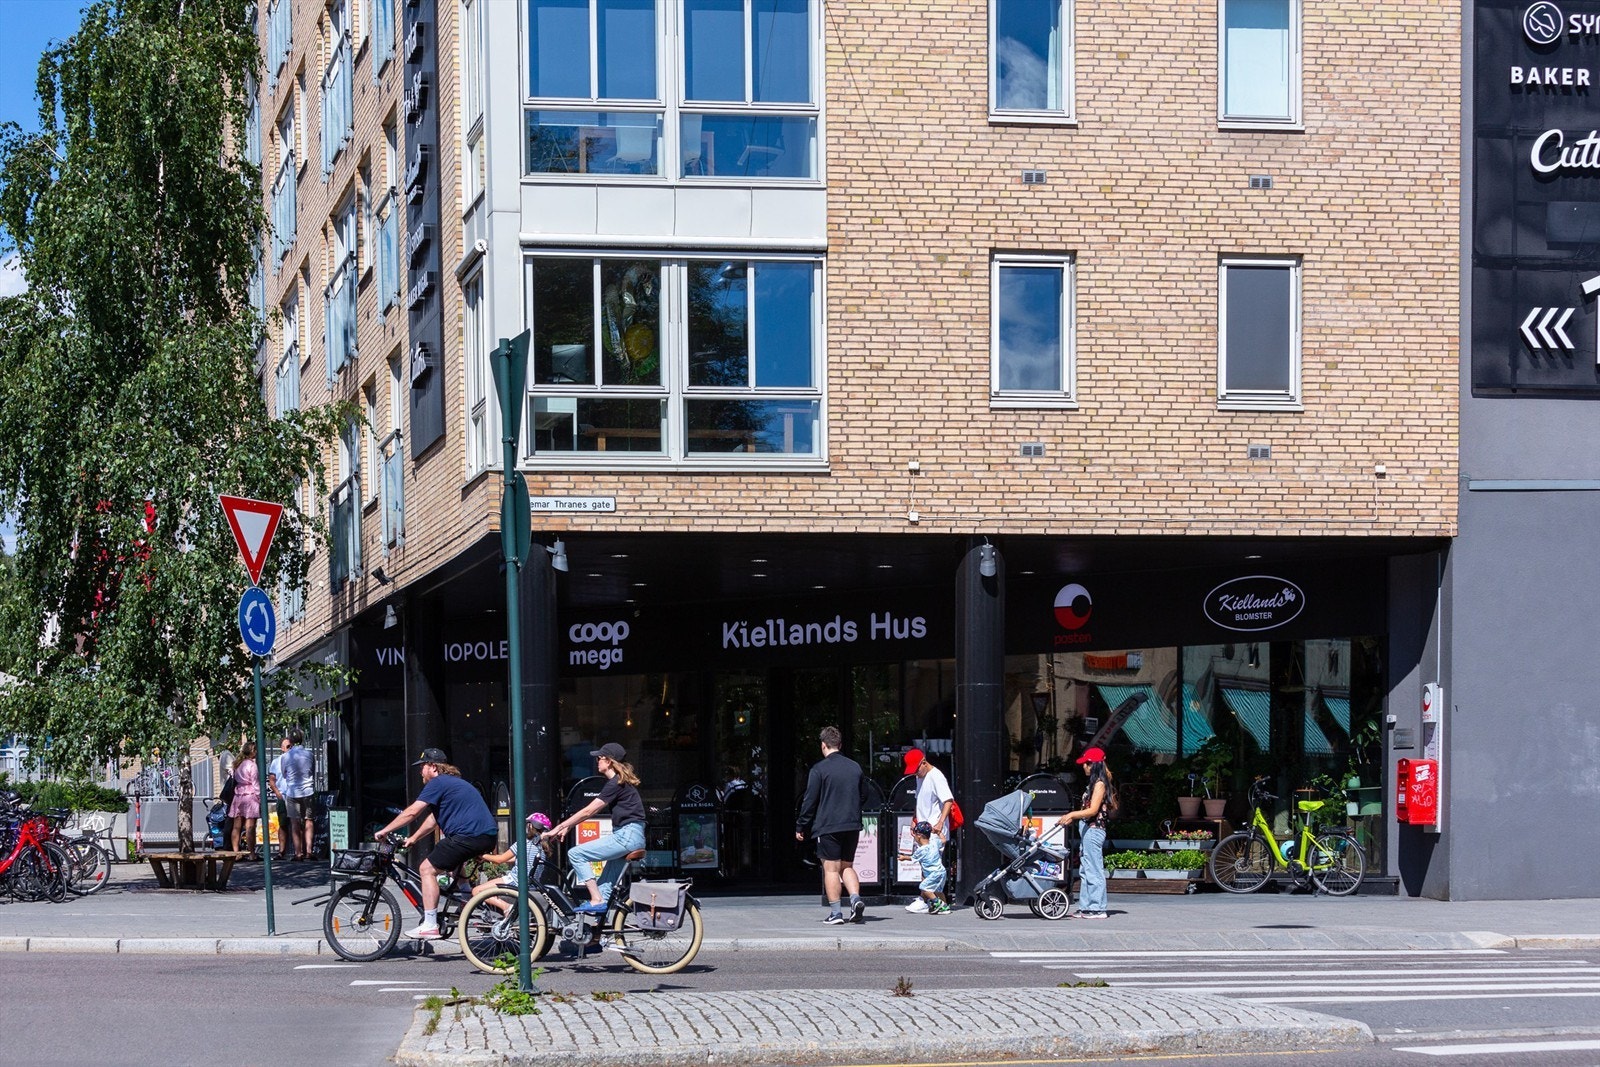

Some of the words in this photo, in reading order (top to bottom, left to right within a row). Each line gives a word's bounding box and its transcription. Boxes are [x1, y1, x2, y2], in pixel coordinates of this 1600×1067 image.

[1510, 66, 1590, 86] BAKER
[529, 501, 550, 509] emar
[554, 500, 588, 509] Thranes
[591, 501, 611, 511] gate
[1218, 592, 1285, 611] Kiellands
[1235, 611, 1273, 621] BLOMSTER
[568, 620, 630, 646] coop
[722, 615, 858, 649] Kiellands
[870, 611, 928, 640] Hus
[1054, 632, 1092, 647] posten
[569, 648, 623, 670] mega
